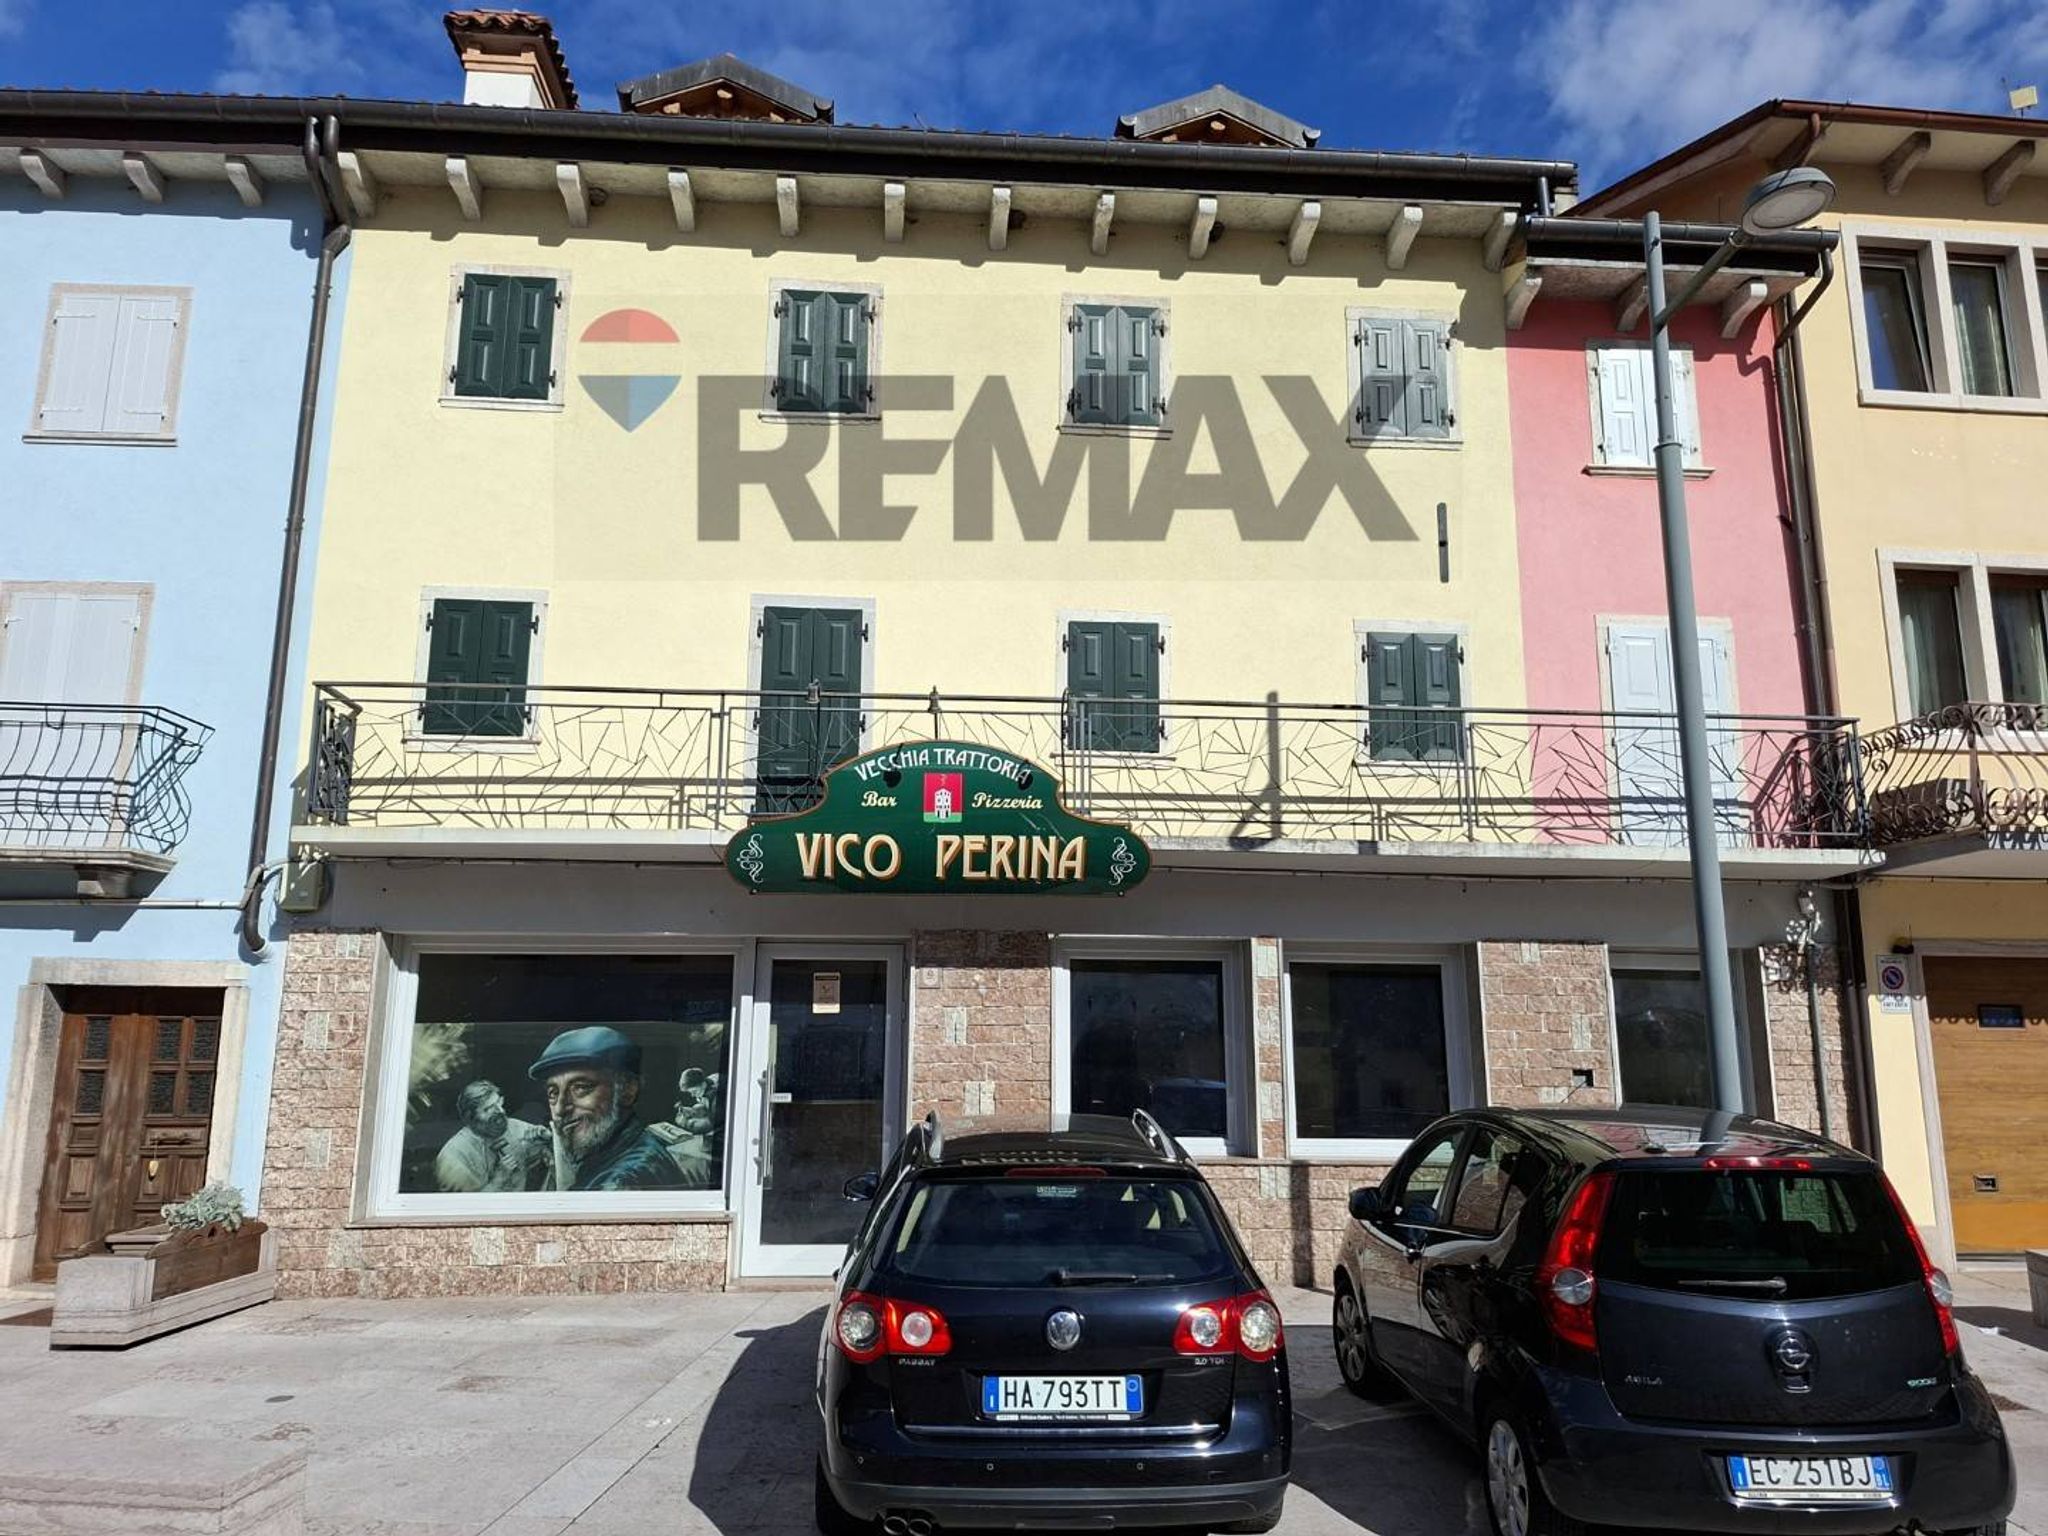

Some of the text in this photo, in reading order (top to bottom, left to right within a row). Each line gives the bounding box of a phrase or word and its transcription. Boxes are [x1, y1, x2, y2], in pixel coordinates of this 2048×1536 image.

[854, 748, 1032, 784] VECCHIA TRATTORIA
[861, 791, 1043, 809] Bar Pizzeria
[796, 833, 1086, 881] VICO PERINA
[1004, 1380, 1034, 1408] HA
[1043, 1380, 1121, 1408] 793TT
